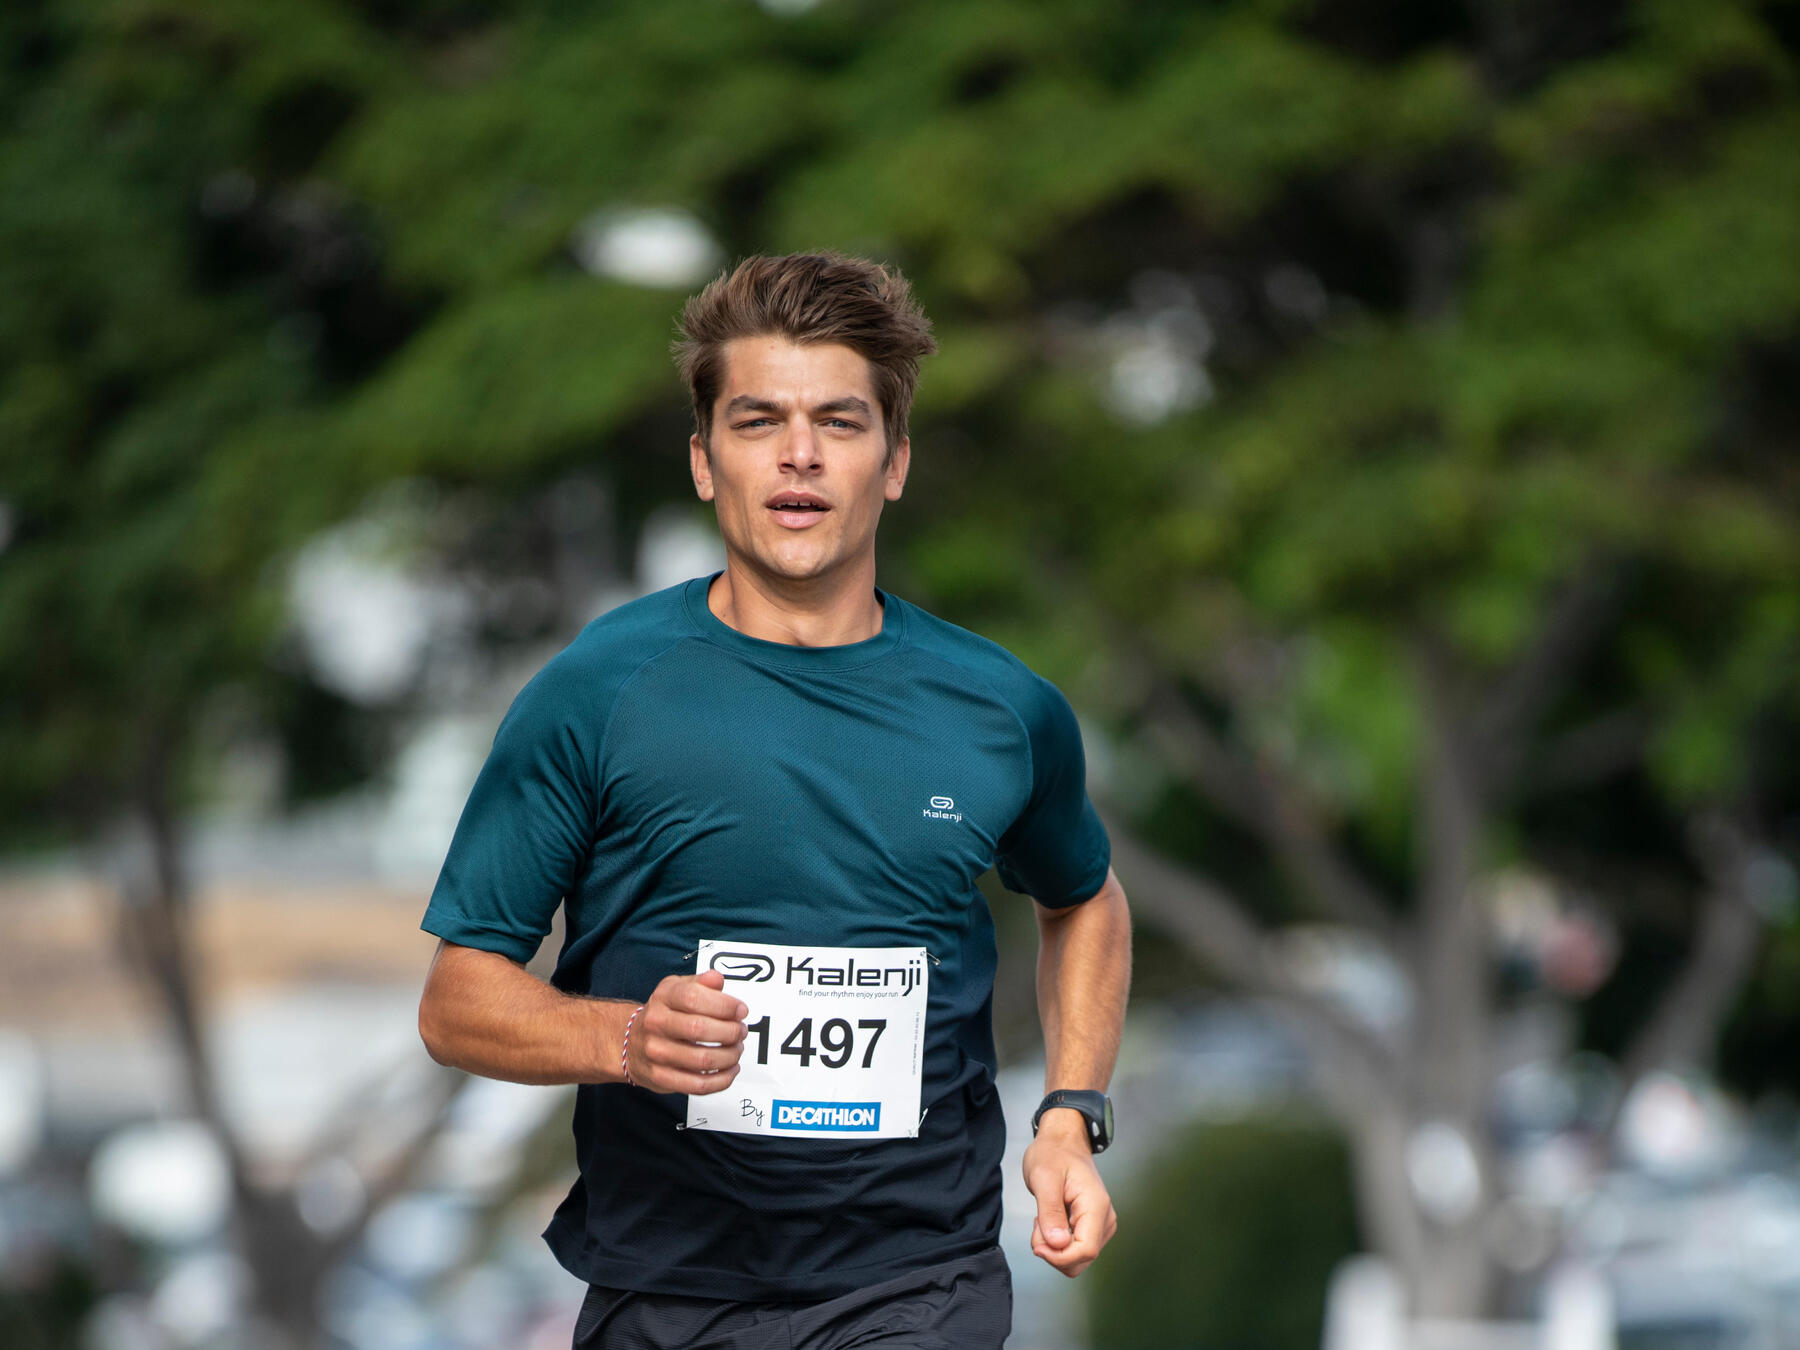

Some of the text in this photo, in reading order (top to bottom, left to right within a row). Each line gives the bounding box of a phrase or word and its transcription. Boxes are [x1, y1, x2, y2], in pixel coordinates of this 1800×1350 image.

[923, 809, 962, 823] Kalenji
[785, 956, 921, 997] Kalenji
[799, 989, 813, 997] find
[814, 990, 829, 998] your
[831, 991, 855, 999] rhythm
[856, 991, 874, 999] enjoy
[747, 1015, 887, 1069] 1497
[740, 1098, 875, 1127] By DECATHLON
